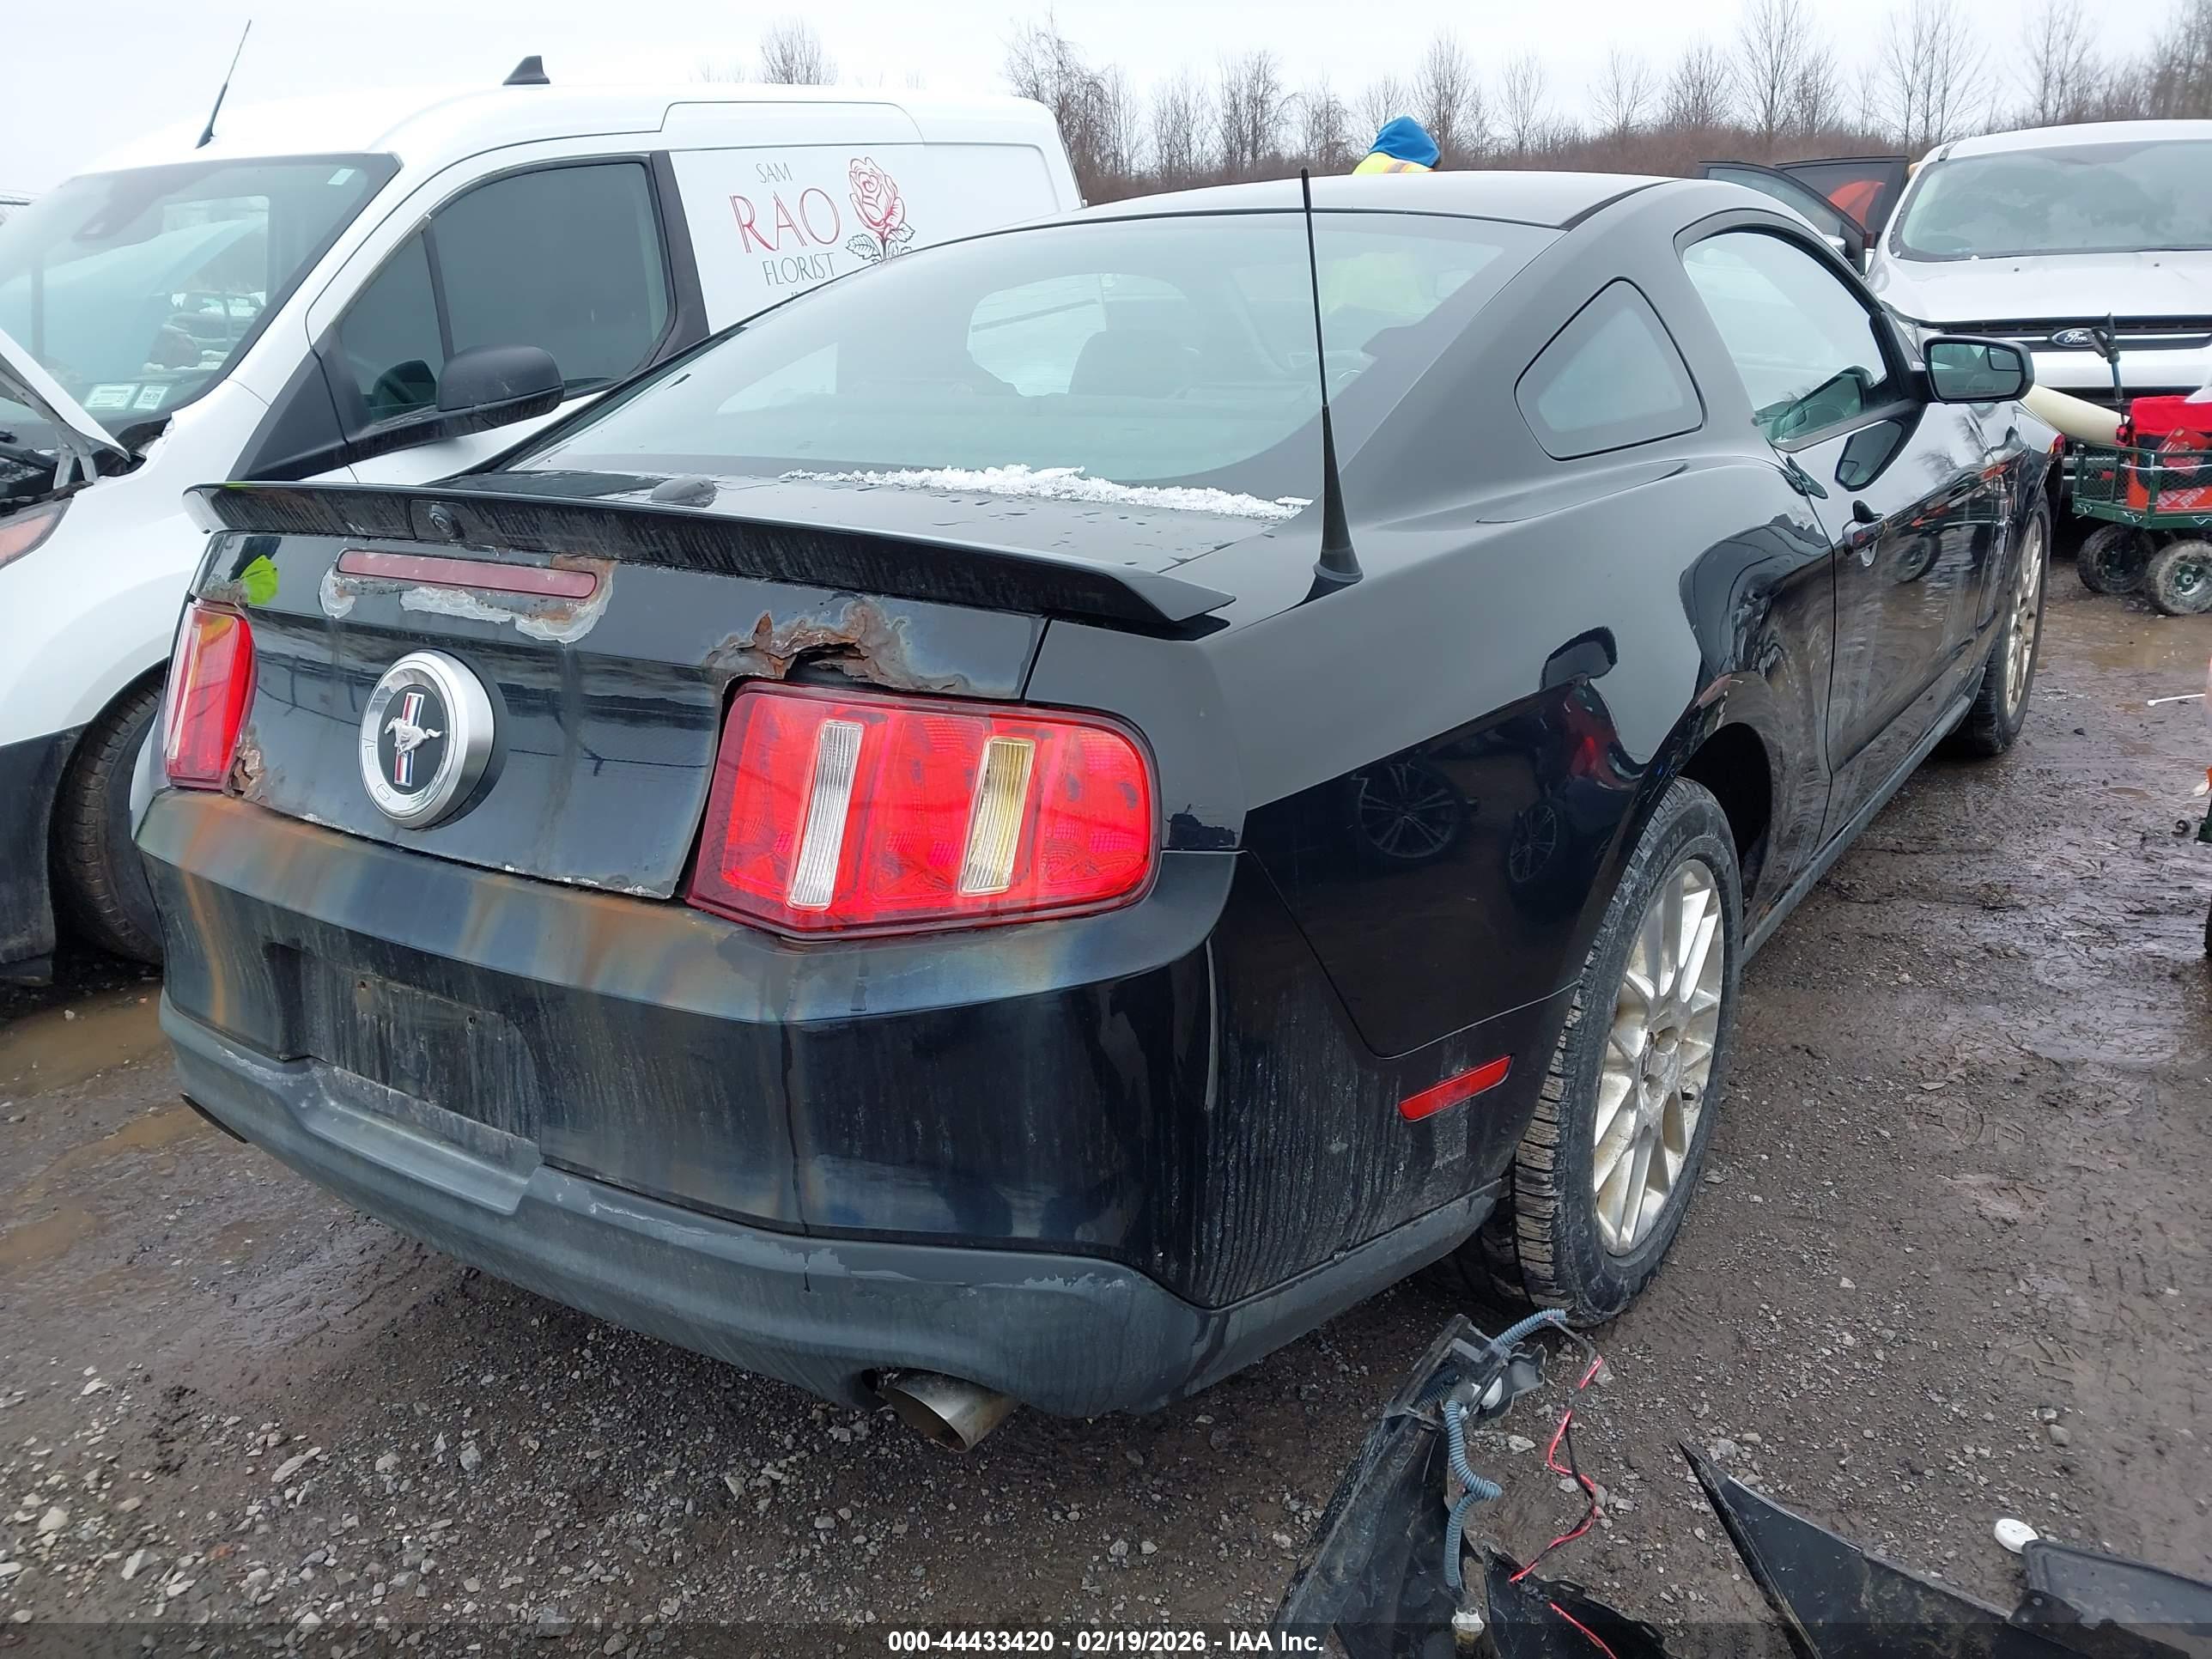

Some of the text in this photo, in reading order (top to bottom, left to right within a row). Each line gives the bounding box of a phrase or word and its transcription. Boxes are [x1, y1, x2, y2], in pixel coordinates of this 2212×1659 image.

[756, 161, 793, 184] SAM
[729, 187, 841, 254] RAO
[762, 252, 836, 287] FLORIST
